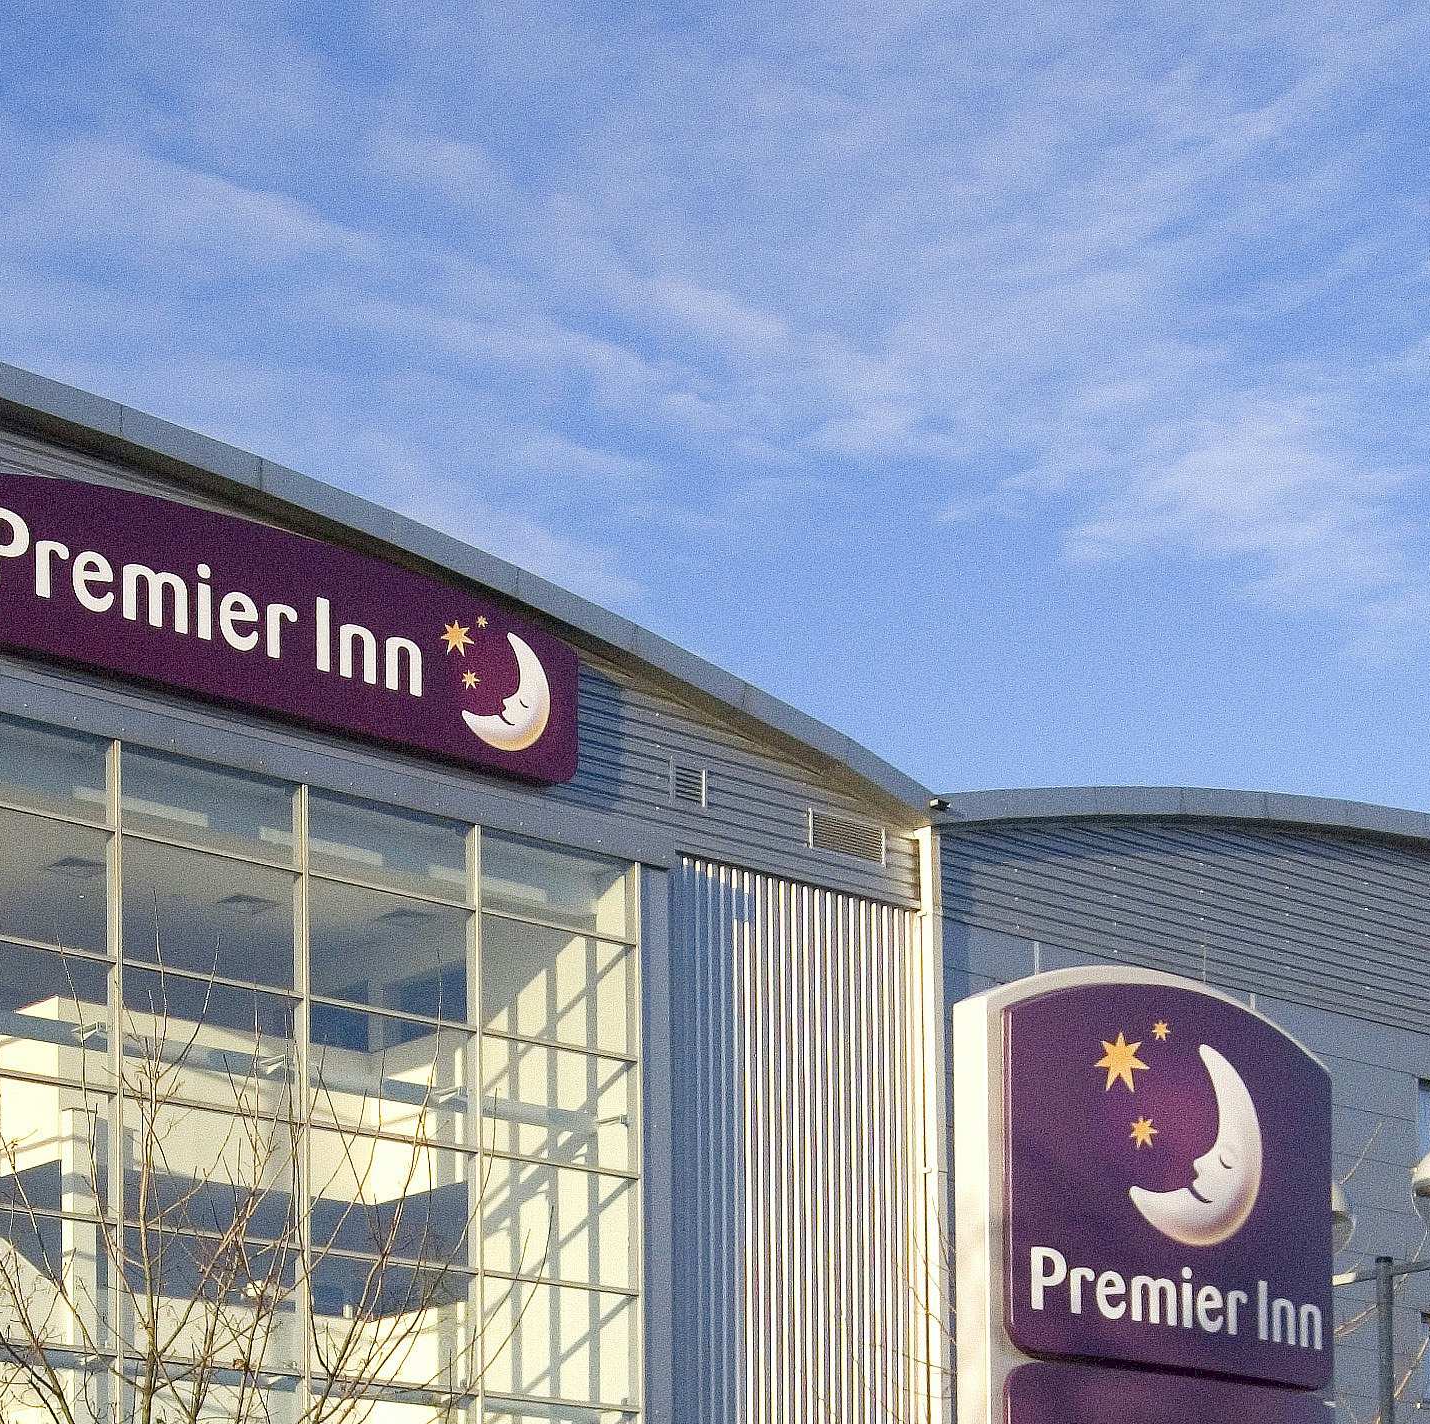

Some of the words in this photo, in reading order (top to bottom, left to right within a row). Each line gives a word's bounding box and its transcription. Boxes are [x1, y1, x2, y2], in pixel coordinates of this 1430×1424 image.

[316, 596, 423, 697] Inn
[1029, 1245, 1248, 1335] Premier
[1258, 1280, 1323, 1351] Inn
